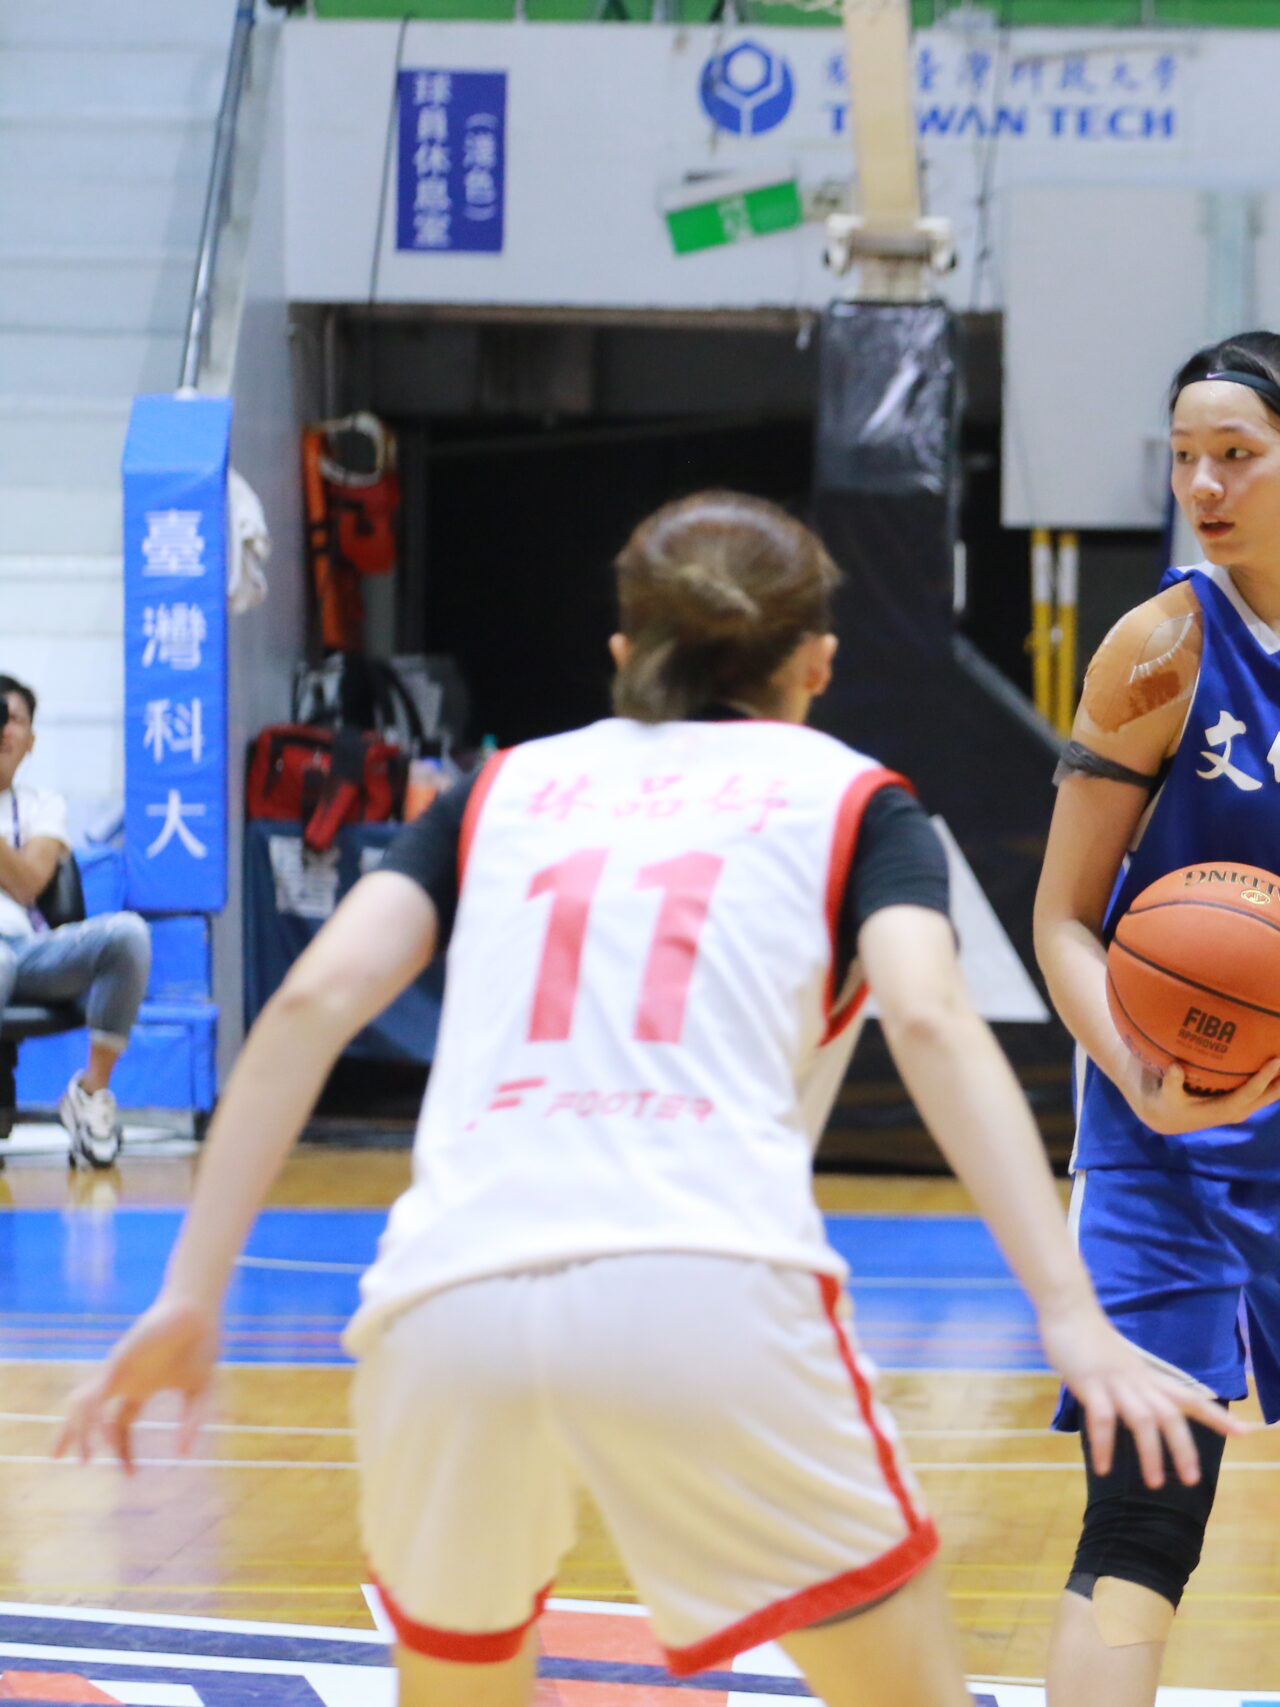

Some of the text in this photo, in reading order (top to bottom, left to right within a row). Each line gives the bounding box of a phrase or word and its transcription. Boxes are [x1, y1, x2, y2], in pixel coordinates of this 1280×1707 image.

[826, 103, 1178, 138] TWAN TECH
[141, 507, 207, 861] 臺灣科大
[525, 848, 725, 1046] 11
[1178, 1028, 1228, 1053] APPROVED
[1183, 1006, 1236, 1043] FIBA
